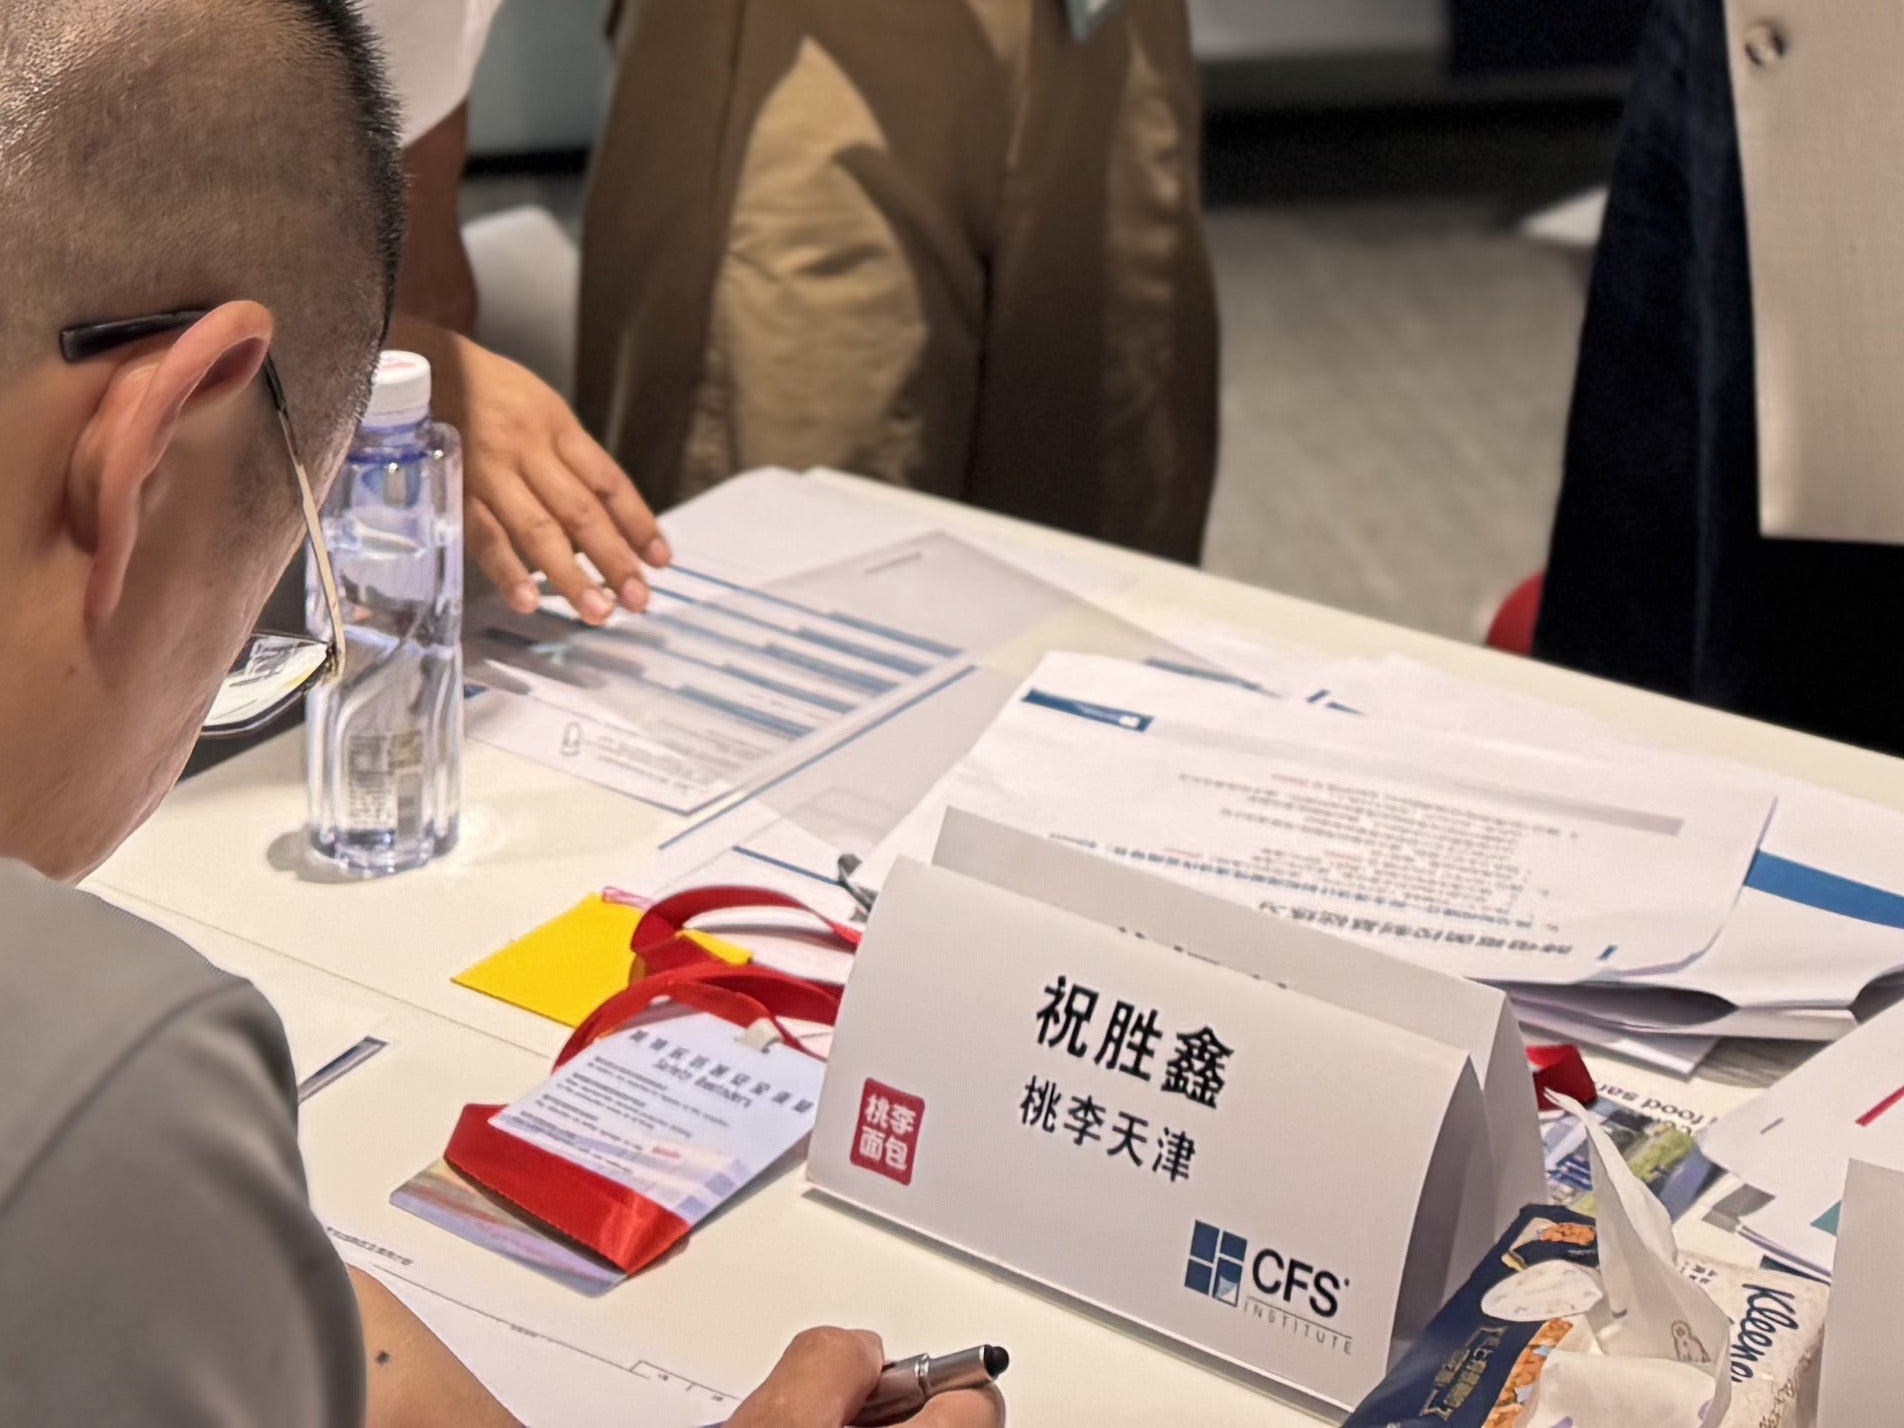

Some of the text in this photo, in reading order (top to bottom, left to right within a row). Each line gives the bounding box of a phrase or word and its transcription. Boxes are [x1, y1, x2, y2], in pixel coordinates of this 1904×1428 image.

[1036, 975, 1234, 1109] 祝胜鑫
[864, 1093, 917, 1136] 桃李
[1020, 1075, 1196, 1182] 桃李天津
[1641, 1098, 1704, 1125] food
[858, 1125, 909, 1172] 面包
[1252, 1248, 1341, 1318] CFS
[1244, 1300, 1353, 1355] INSTITUTE
[1729, 1282, 1800, 1384] Kleene
